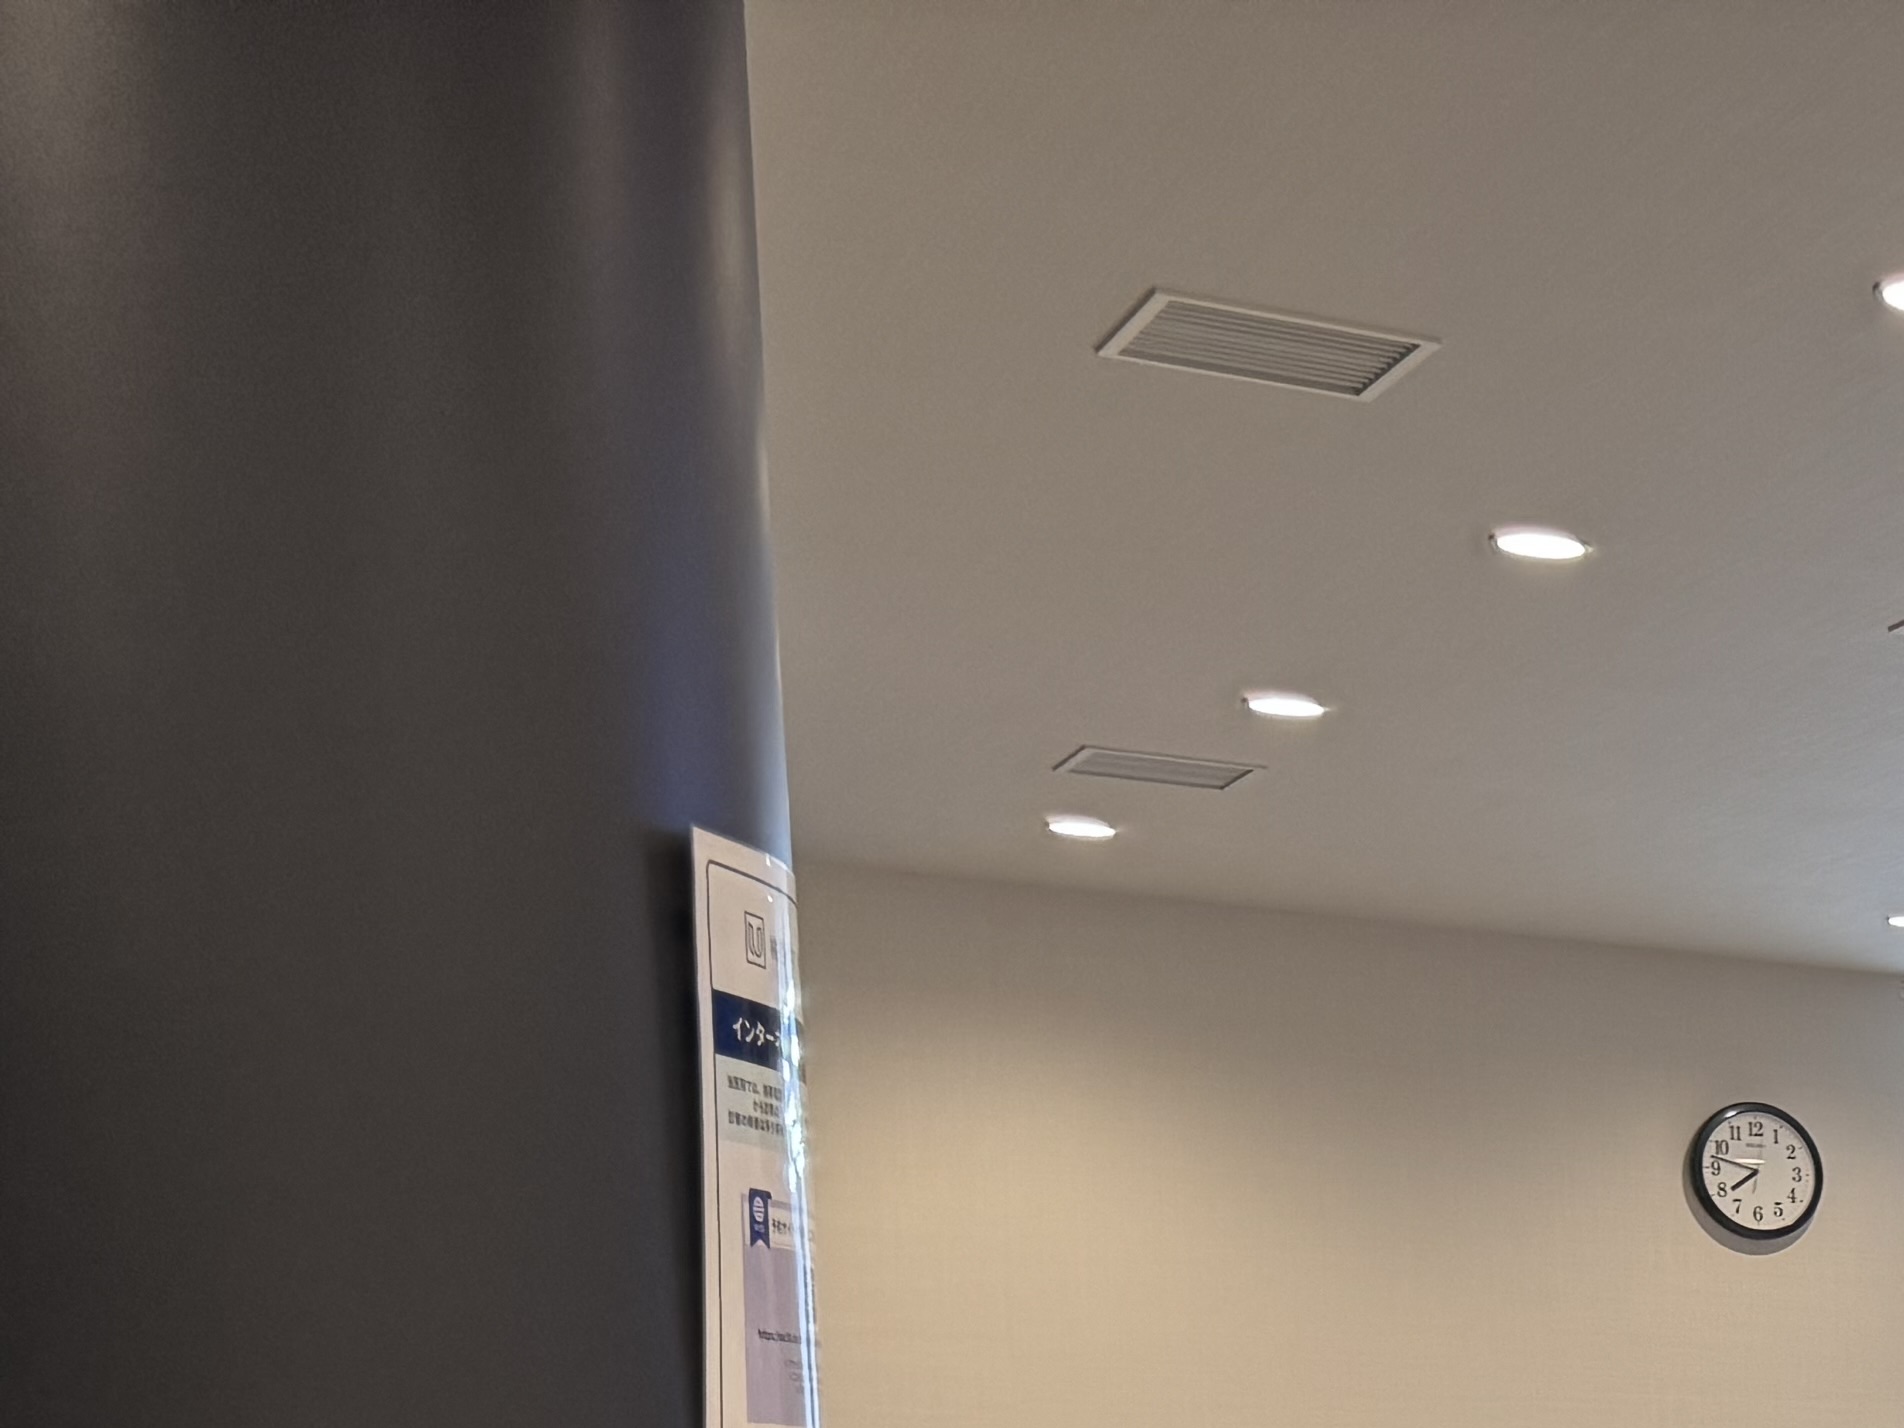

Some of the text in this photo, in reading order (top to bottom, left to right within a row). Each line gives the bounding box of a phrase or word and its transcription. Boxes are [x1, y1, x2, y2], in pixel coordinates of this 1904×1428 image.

[1729, 1125, 1741, 1141] 11
[1748, 1121, 1763, 1137] 12
[1773, 1129, 1779, 1144] 1
[1714, 1140, 1729, 1155] 10
[1786, 1144, 1796, 1159] 2
[1711, 1161, 1721, 1176] 9
[1792, 1167, 1802, 1182] 3
[1717, 1182, 1727, 1197] 8
[1787, 1188, 1797, 1203] 4
[1732, 1199, 1742, 1214] 7
[1753, 1206, 1763, 1221] 6
[1774, 1202, 1783, 1217] 5
